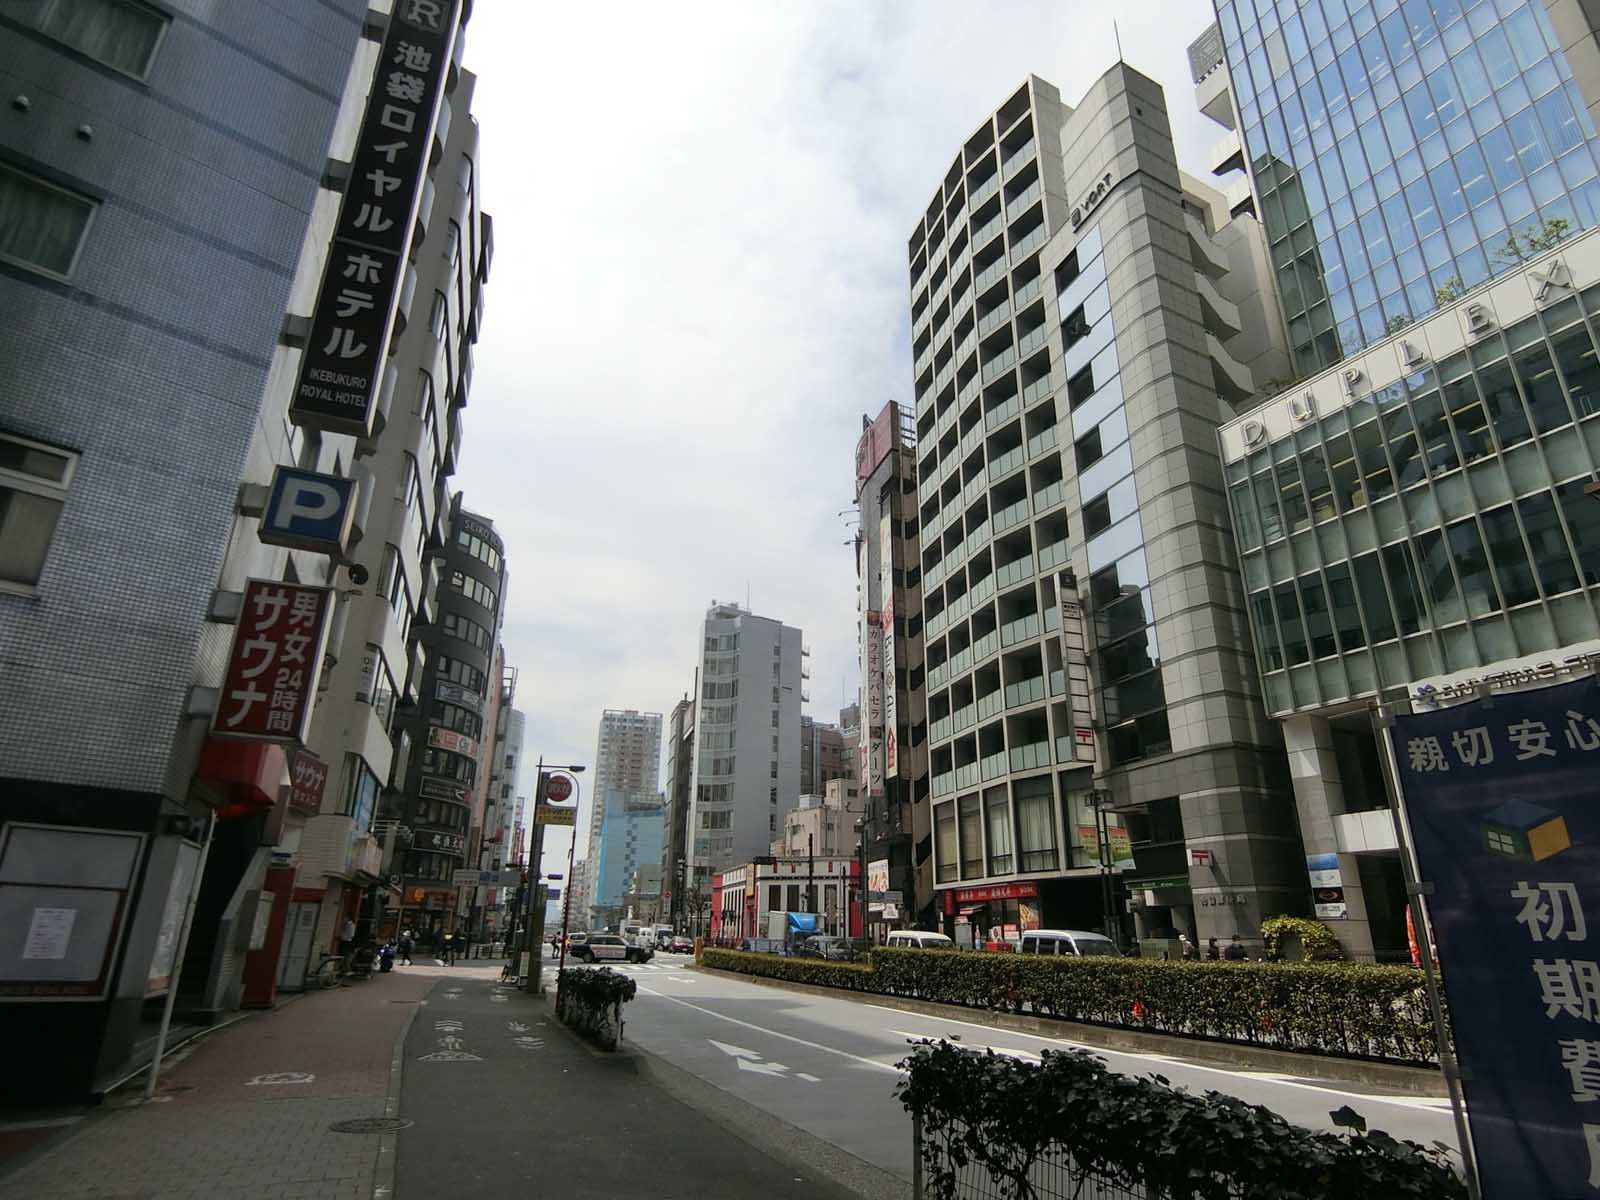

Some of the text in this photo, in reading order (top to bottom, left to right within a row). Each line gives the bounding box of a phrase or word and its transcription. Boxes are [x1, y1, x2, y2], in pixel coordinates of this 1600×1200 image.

[309, 367, 368, 390] IKEBUKURO
[1241, 259, 1571, 446] DUPLEX
[299, 383, 367, 408] ROYAL HOTEL
[273, 476, 342, 531] P
[226, 585, 290, 729] サウナ
